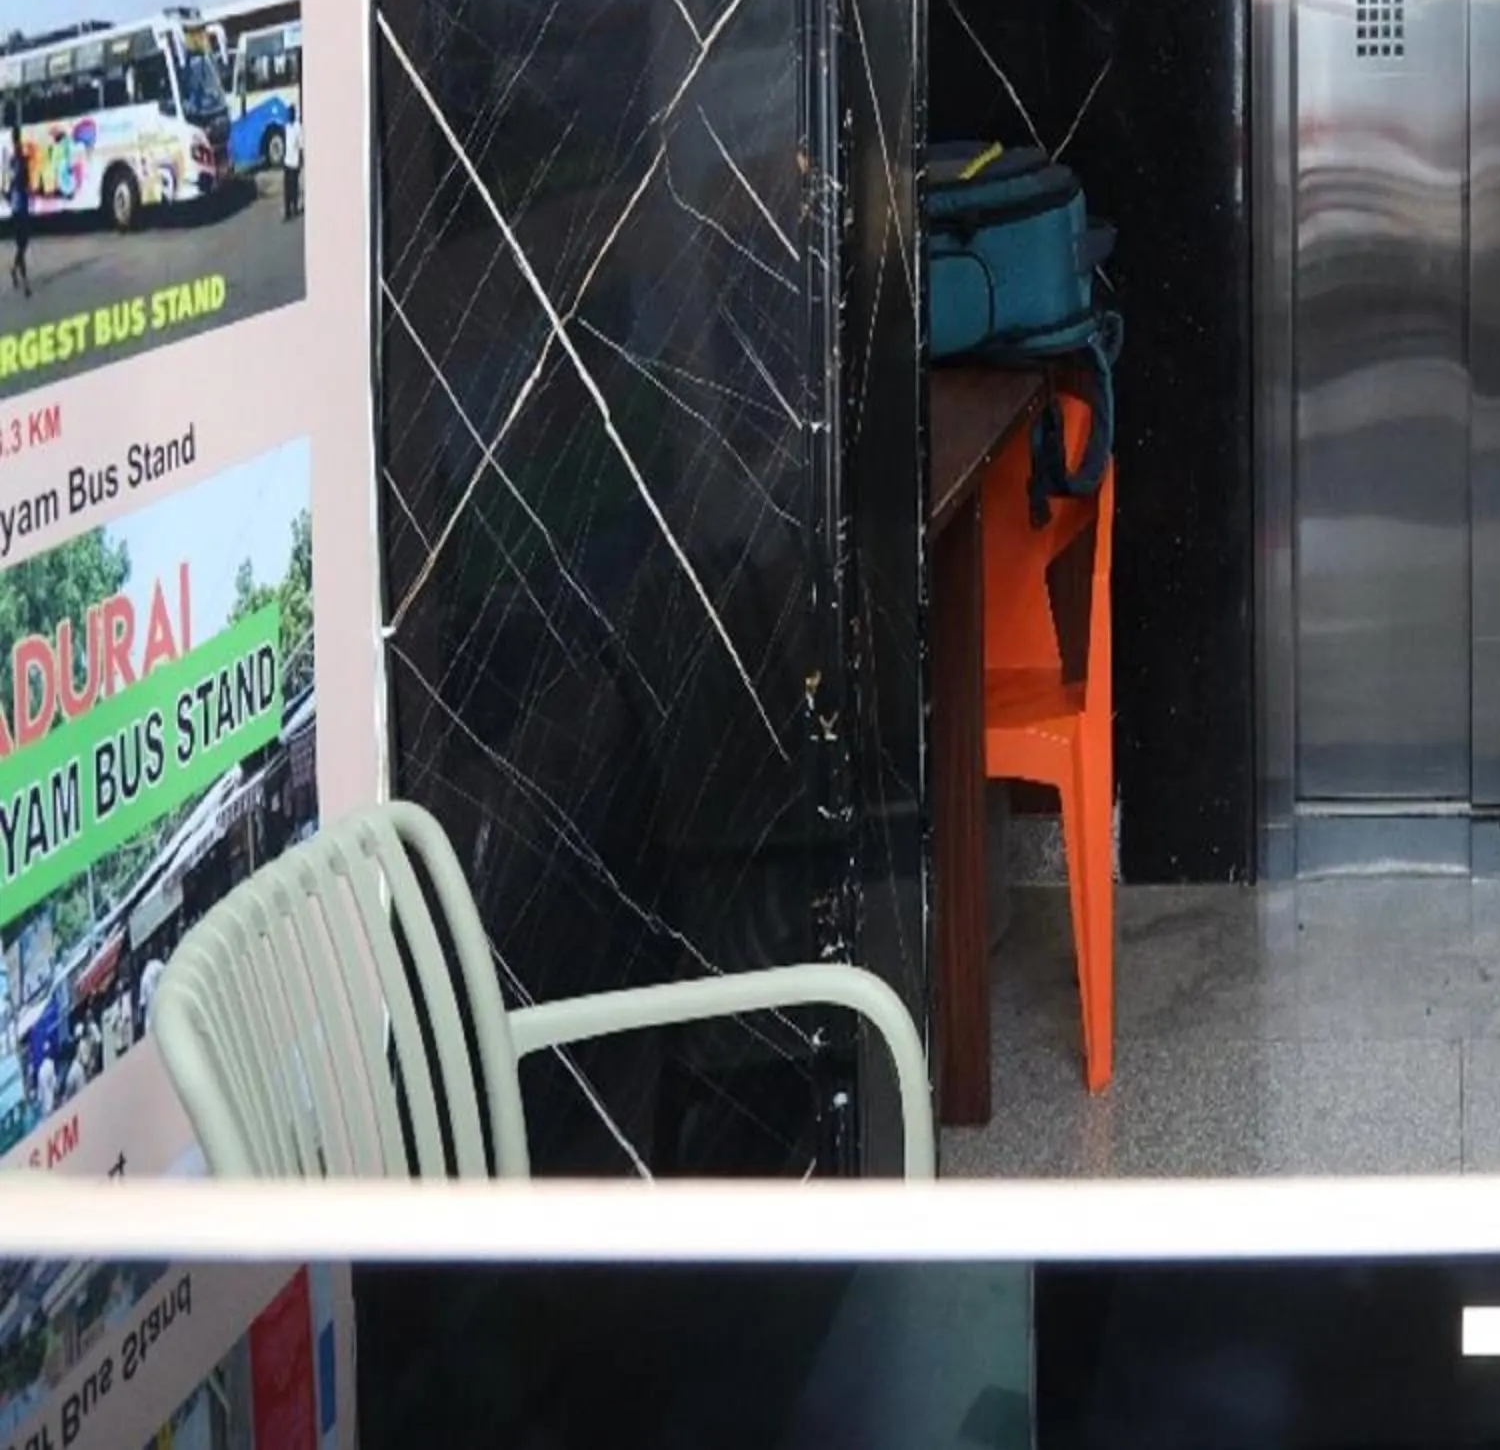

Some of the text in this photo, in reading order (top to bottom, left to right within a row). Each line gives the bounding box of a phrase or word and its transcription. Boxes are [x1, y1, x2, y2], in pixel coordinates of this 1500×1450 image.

[94, 296, 147, 347] BUS
[151, 274, 227, 331] STAND
[28, 405, 61, 447] KM
[0, 421, 196, 557] yam Bus Stand
[0, 643, 277, 877] YAM BUS STAND
[47, 1114, 79, 1171] KM
